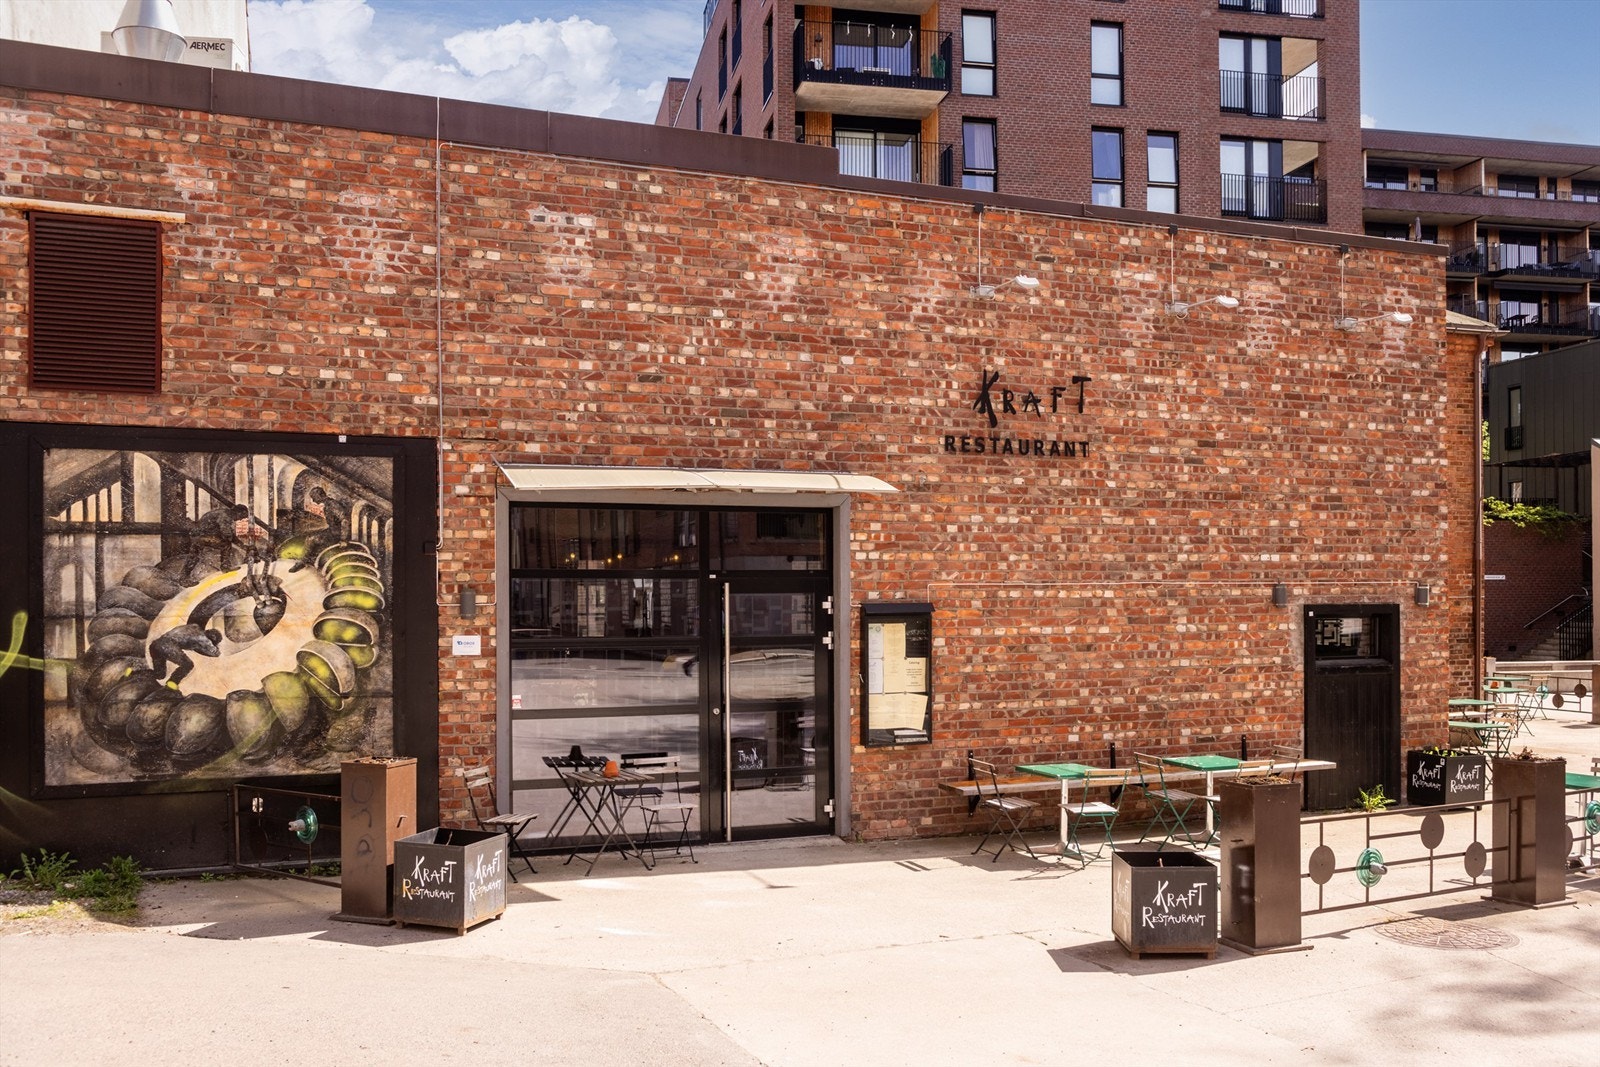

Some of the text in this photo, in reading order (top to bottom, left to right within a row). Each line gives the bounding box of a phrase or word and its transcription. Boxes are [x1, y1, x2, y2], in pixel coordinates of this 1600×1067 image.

[190, 41, 226, 52] AERMEC
[972, 368, 1092, 428] KRAFT
[944, 434, 1090, 458] RESTAURANT
[1417, 760, 1443, 780] KRAFT
[1455, 764, 1482, 784] KRAFT
[411, 855, 457, 887] KRAFT
[475, 849, 503, 885] KRAFT
[402, 878, 455, 903] RESTAURANT
[1152, 880, 1208, 914] KRAFT
[1142, 905, 1206, 929] RESTAURANT
